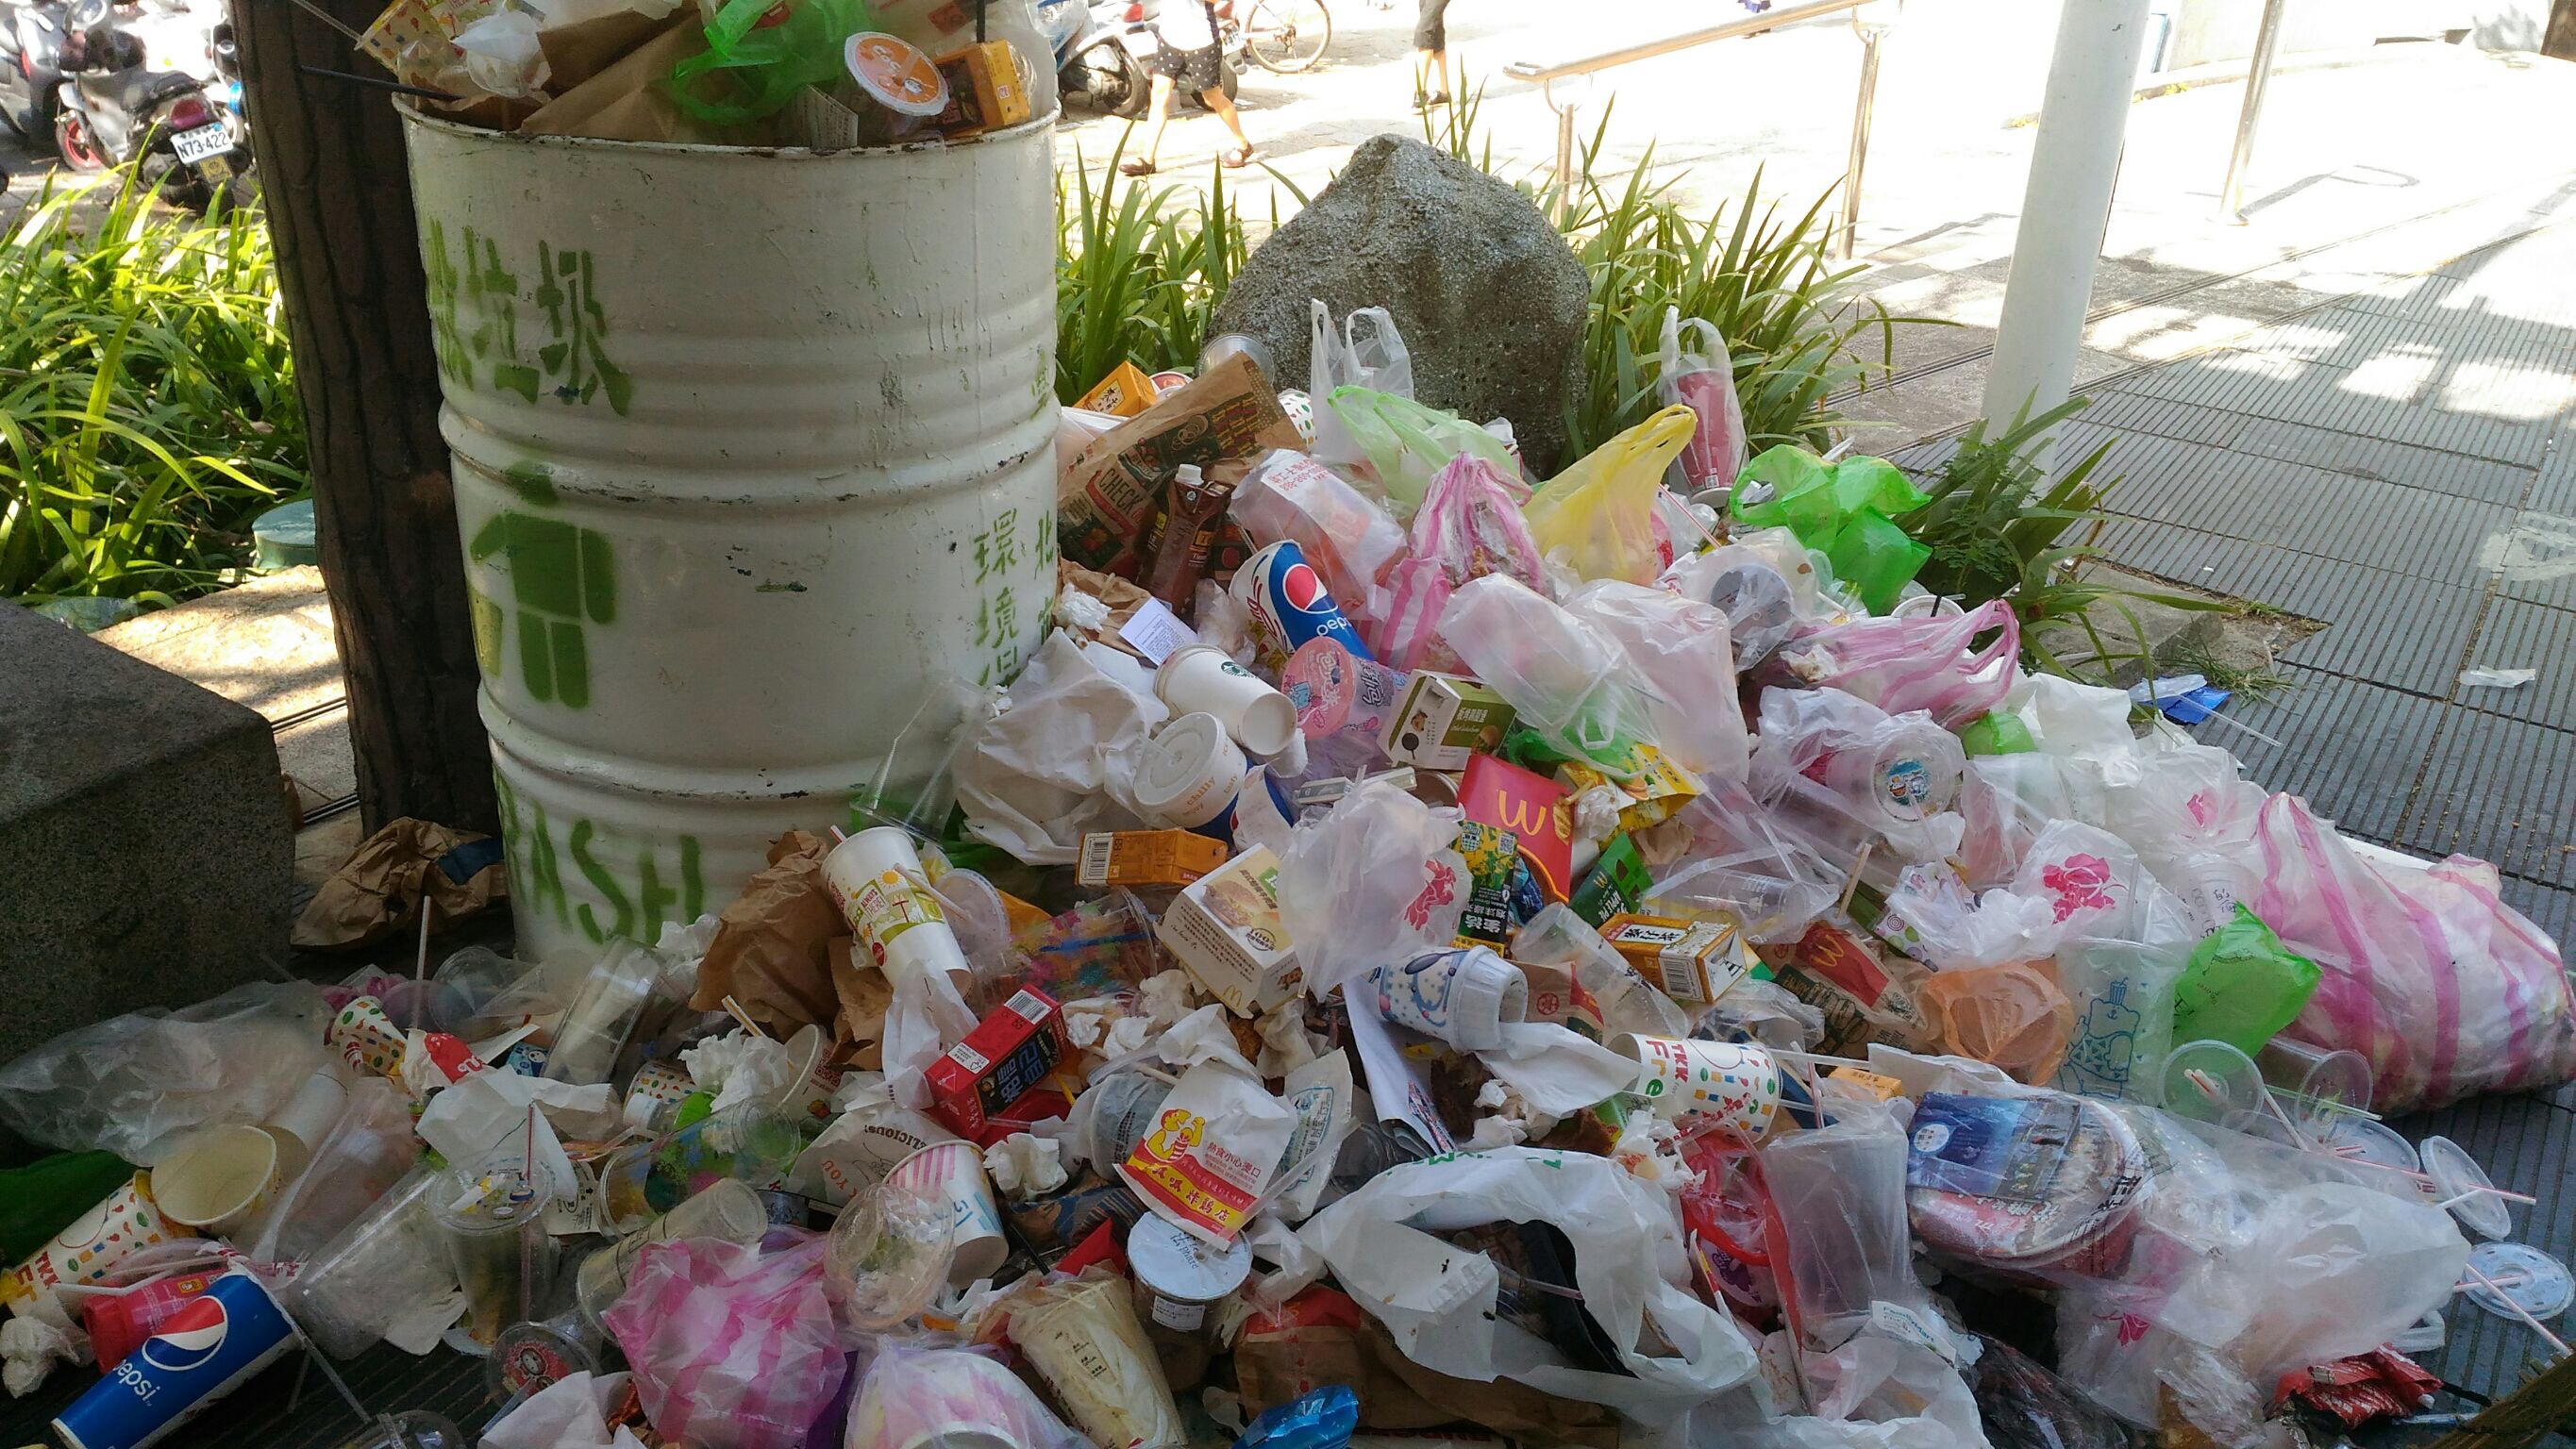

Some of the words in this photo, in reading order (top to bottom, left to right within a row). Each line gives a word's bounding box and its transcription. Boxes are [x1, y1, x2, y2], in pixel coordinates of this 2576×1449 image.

[1098, 468, 1144, 514] CHECK
[1185, 774, 1216, 808] chilly
[1464, 914, 1501, 934] 生活
[1671, 1043, 1689, 1083] TKK
[863, 1124, 928, 1152] ELICIOUS!
[820, 1159, 848, 1191] YOU
